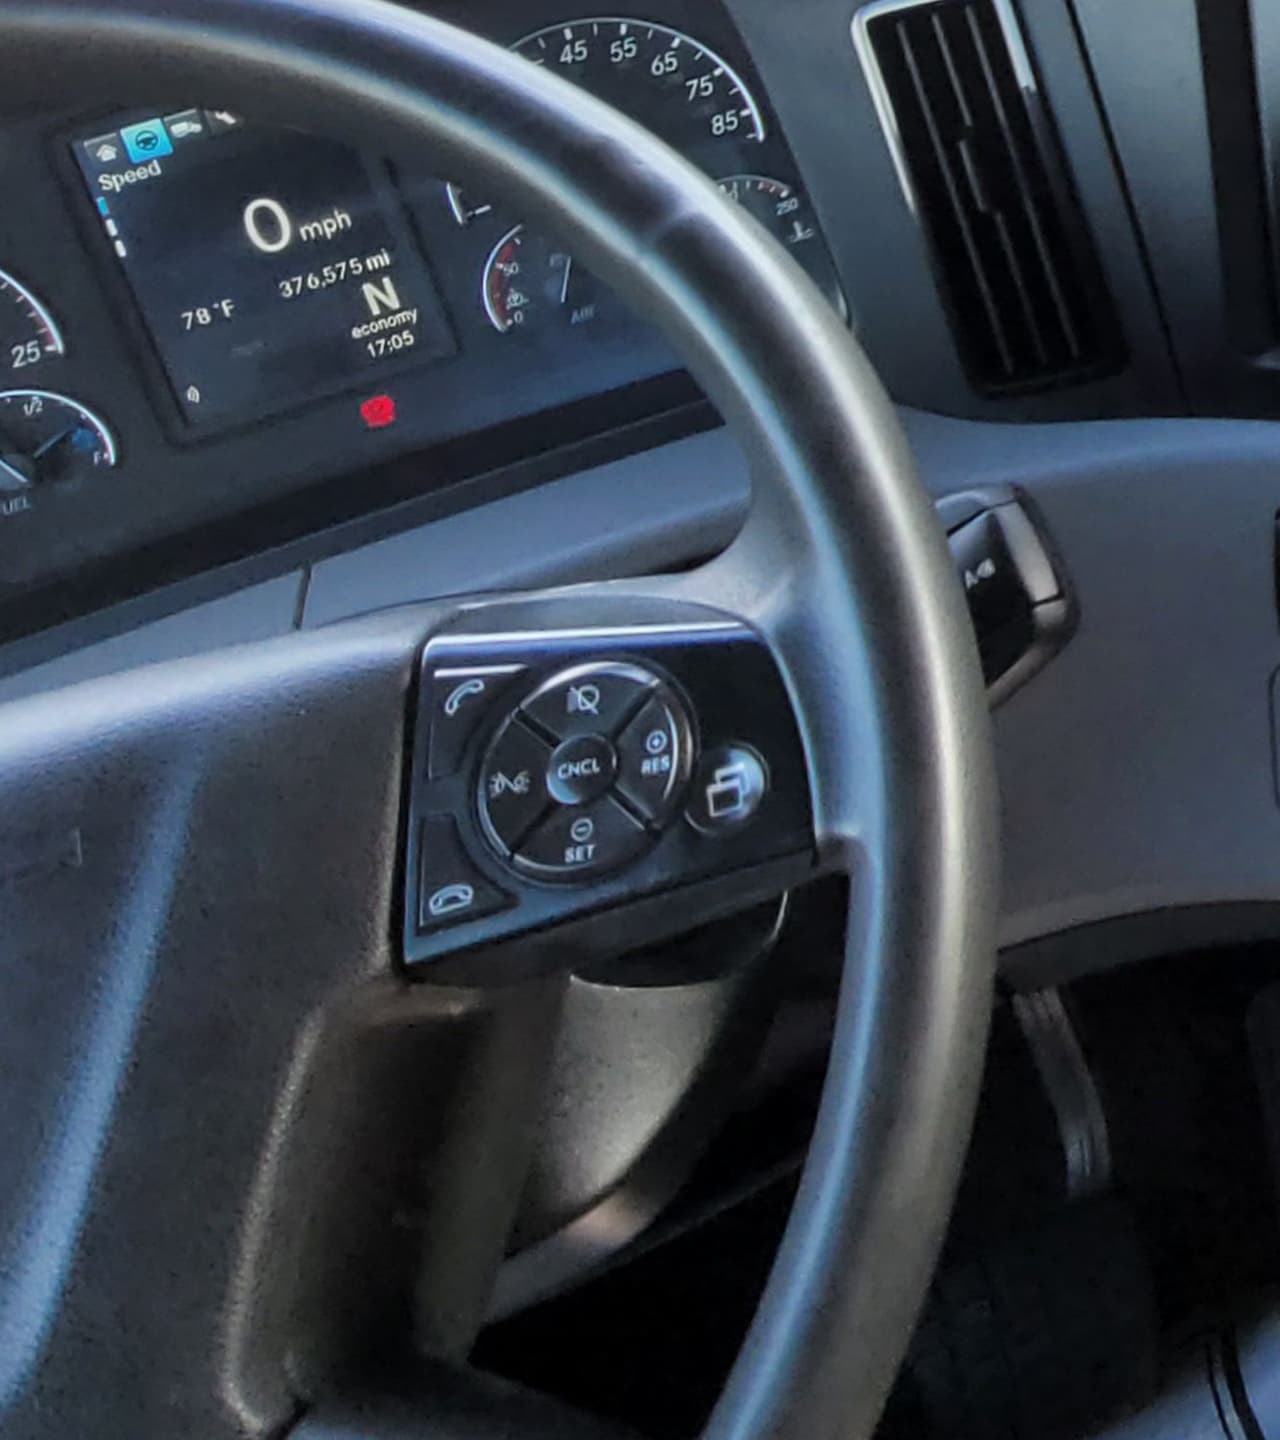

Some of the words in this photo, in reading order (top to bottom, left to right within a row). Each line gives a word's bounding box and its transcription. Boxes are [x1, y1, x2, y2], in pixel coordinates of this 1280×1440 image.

[559, 40, 588, 65] 45
[610, 37, 638, 63] 55
[651, 50, 679, 76] 65
[685, 75, 714, 102] 75
[711, 110, 739, 136] 85
[97, 159, 162, 193] Speed
[775, 196, 798, 216] 250
[243, 198, 292, 253] 0
[299, 209, 352, 243] mph
[365, 248, 391, 273] mi
[361, 276, 401, 317] N
[350, 308, 418, 340] economy
[11, 339, 41, 368] 25
[367, 330, 415, 358] 17:05
[557, 757, 600, 779] CNCL
[641, 753, 670, 775] RES
[564, 844, 595, 864] SET
